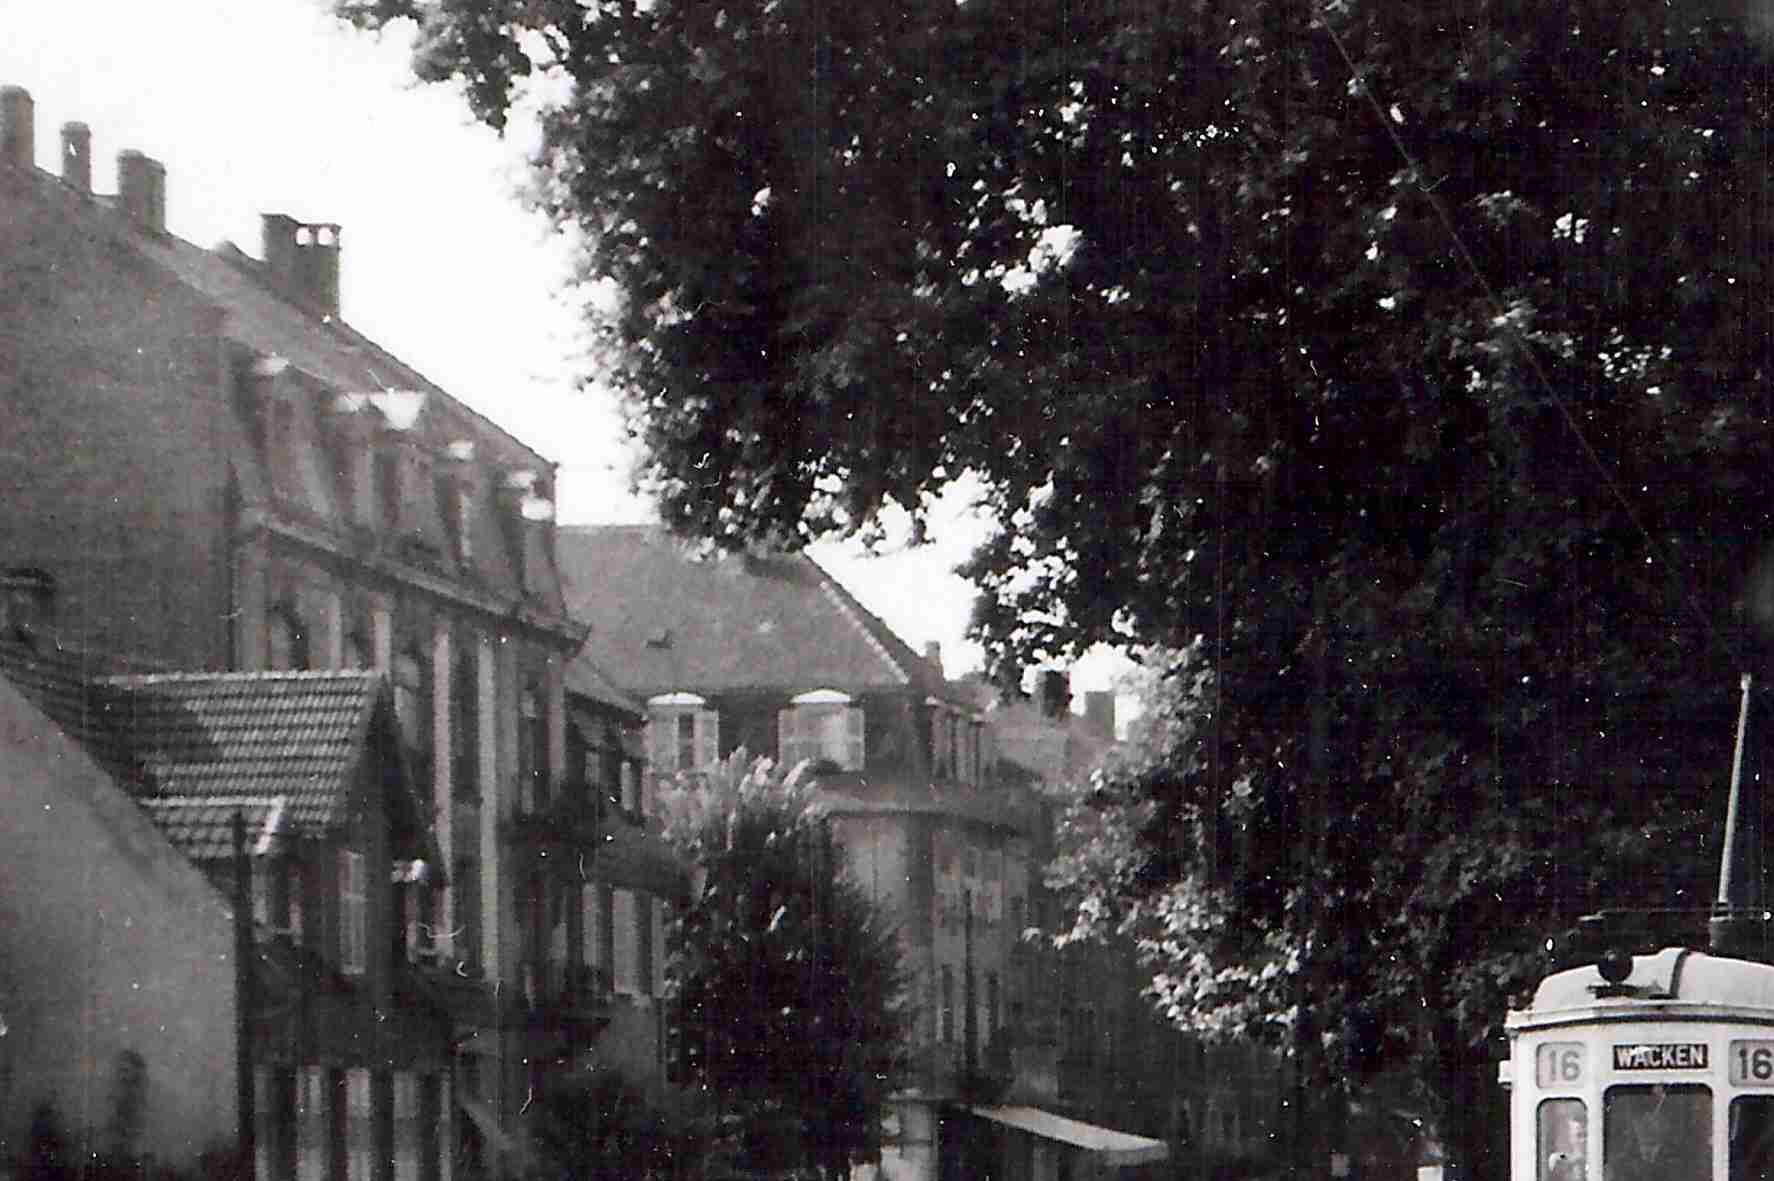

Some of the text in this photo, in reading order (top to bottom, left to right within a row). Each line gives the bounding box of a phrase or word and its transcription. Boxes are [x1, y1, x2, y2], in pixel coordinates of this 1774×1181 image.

[1547, 1051, 1579, 1081] 16
[1616, 1045, 1704, 1068] WACKEN
[1737, 1049, 1772, 1080] 16
